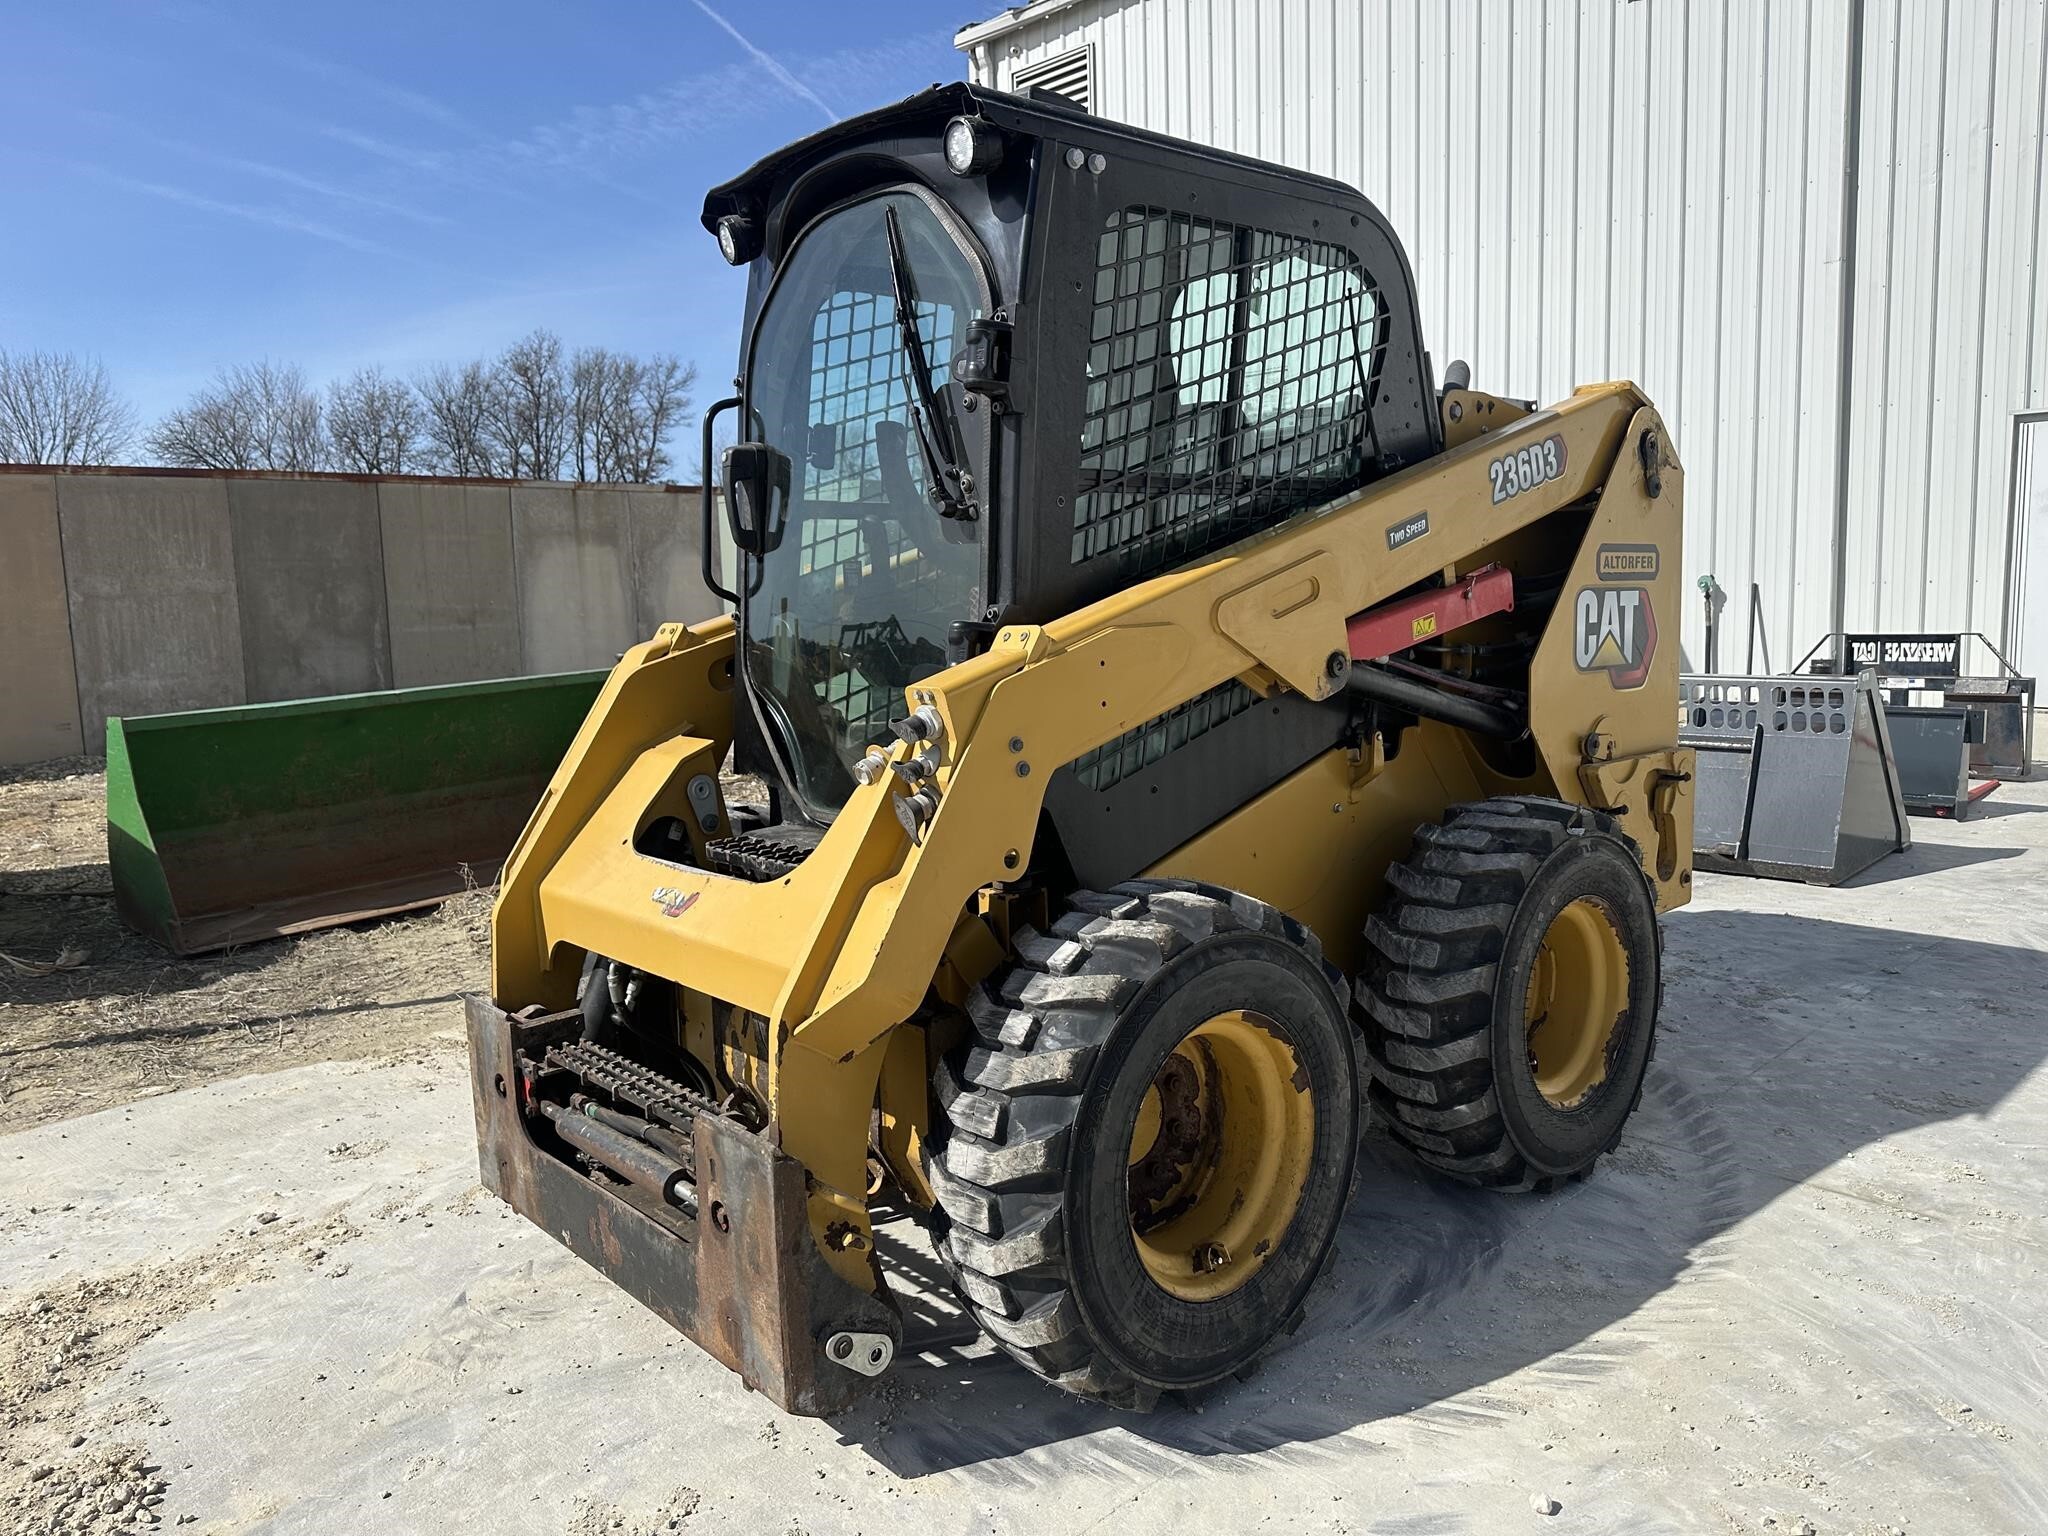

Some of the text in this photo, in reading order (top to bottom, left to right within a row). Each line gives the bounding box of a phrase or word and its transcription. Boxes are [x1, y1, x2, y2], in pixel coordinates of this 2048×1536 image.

[1490, 439, 1558, 503] 236D3
[1603, 554, 1654, 568] ALTORFER
[1577, 589, 1639, 667] CAT
